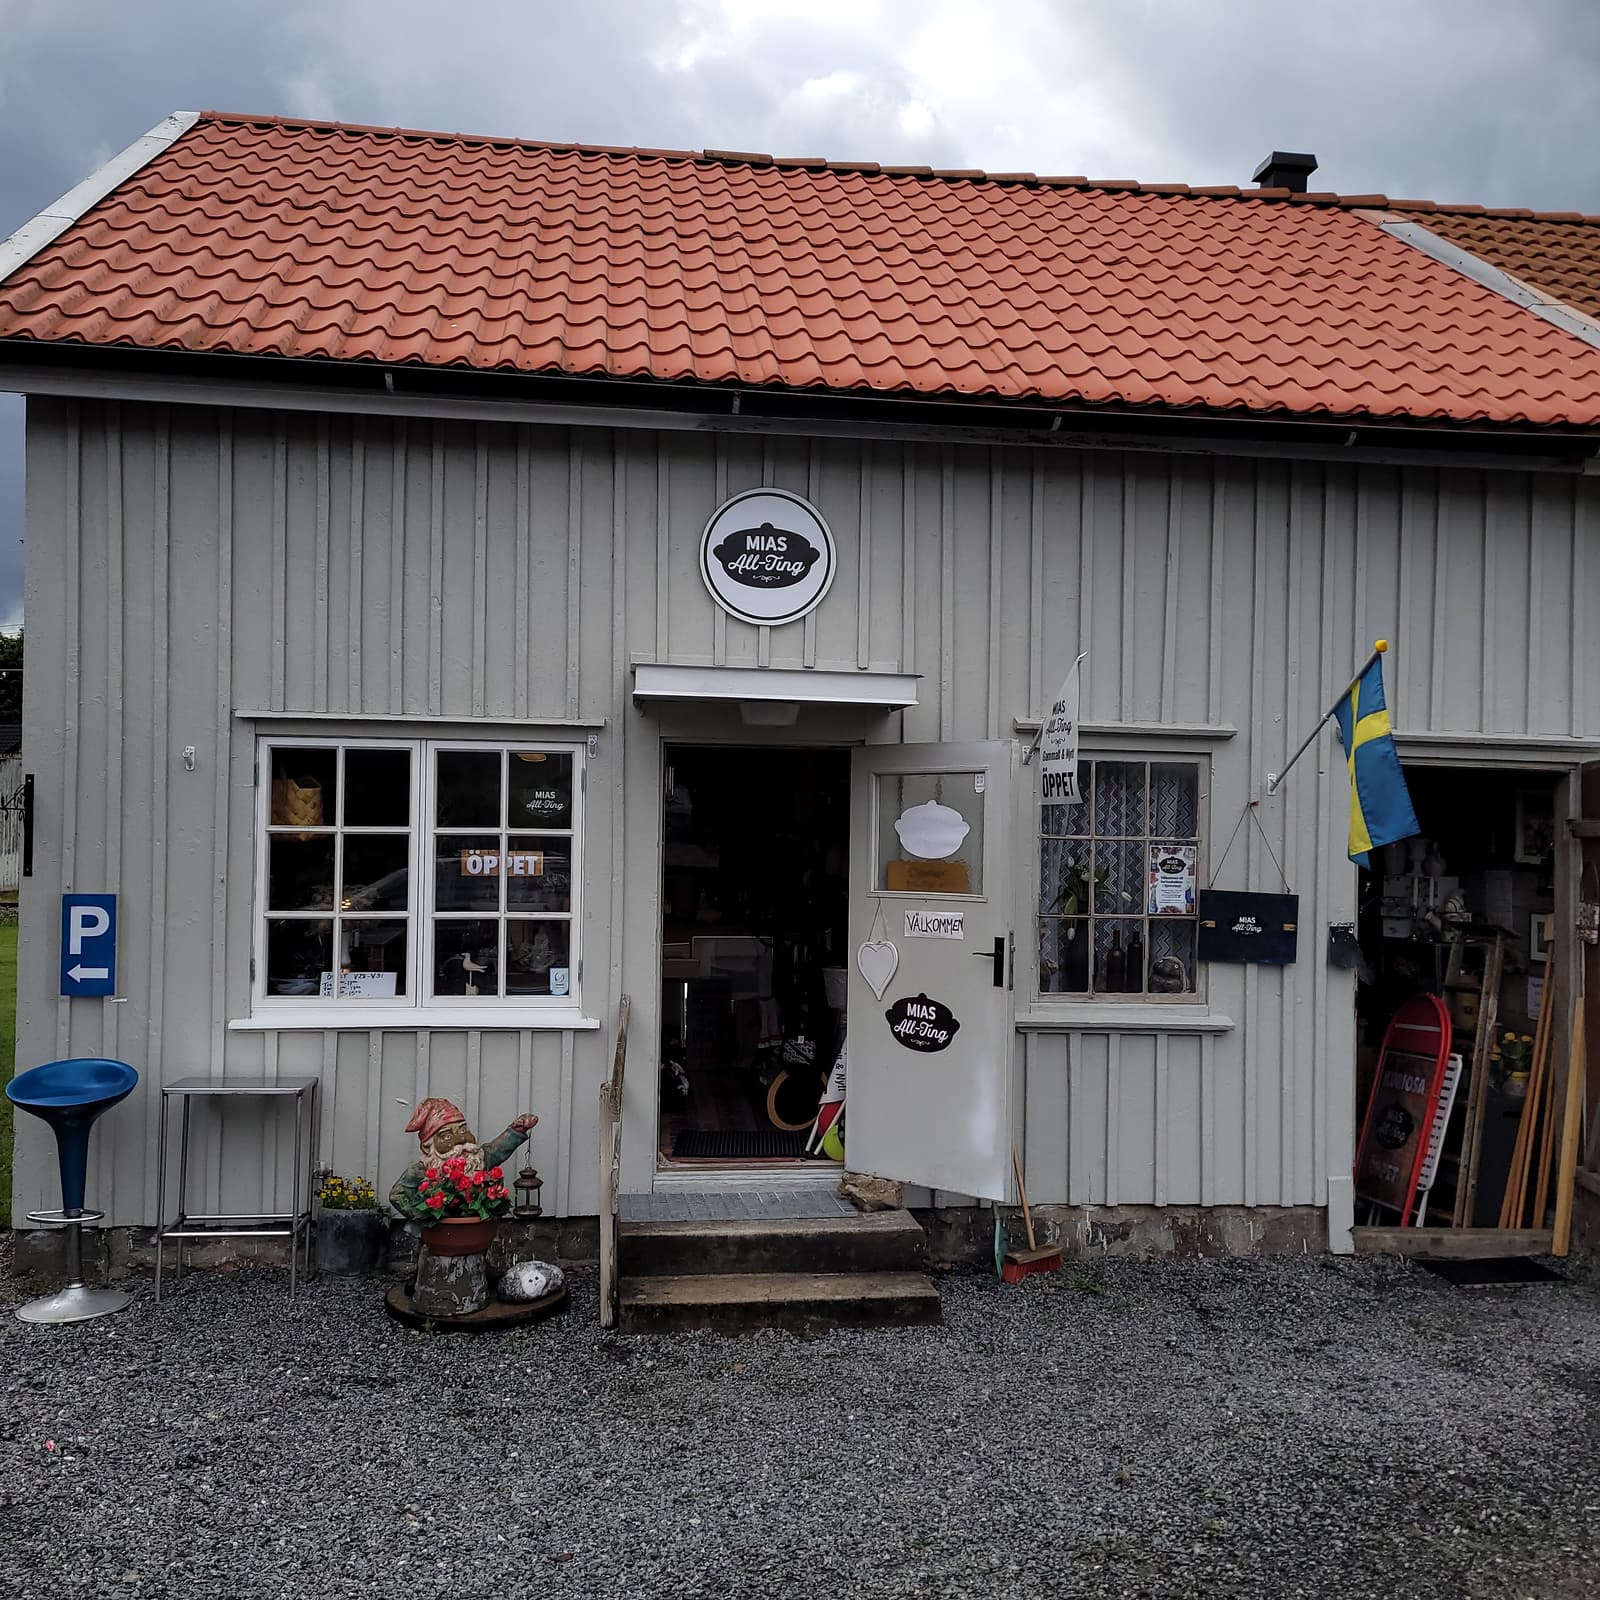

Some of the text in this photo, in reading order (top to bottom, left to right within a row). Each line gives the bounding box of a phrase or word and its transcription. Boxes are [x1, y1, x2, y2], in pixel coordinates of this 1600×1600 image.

[746, 535, 788, 552] MIAS
[727, 553, 806, 577] All-Ting
[1052, 699, 1066, 715] MIAS
[1042, 767, 1074, 798] ÖPPET
[535, 791, 556, 800] MIAS
[526, 799, 565, 811] All-Ting
[906, 912, 964, 935] VÄLKOMMEN
[1239, 916, 1256, 924] MIAS
[69, 905, 110, 955] P
[907, 1002, 936, 1020] MIAS
[894, 1018, 949, 1044] All-Ting
